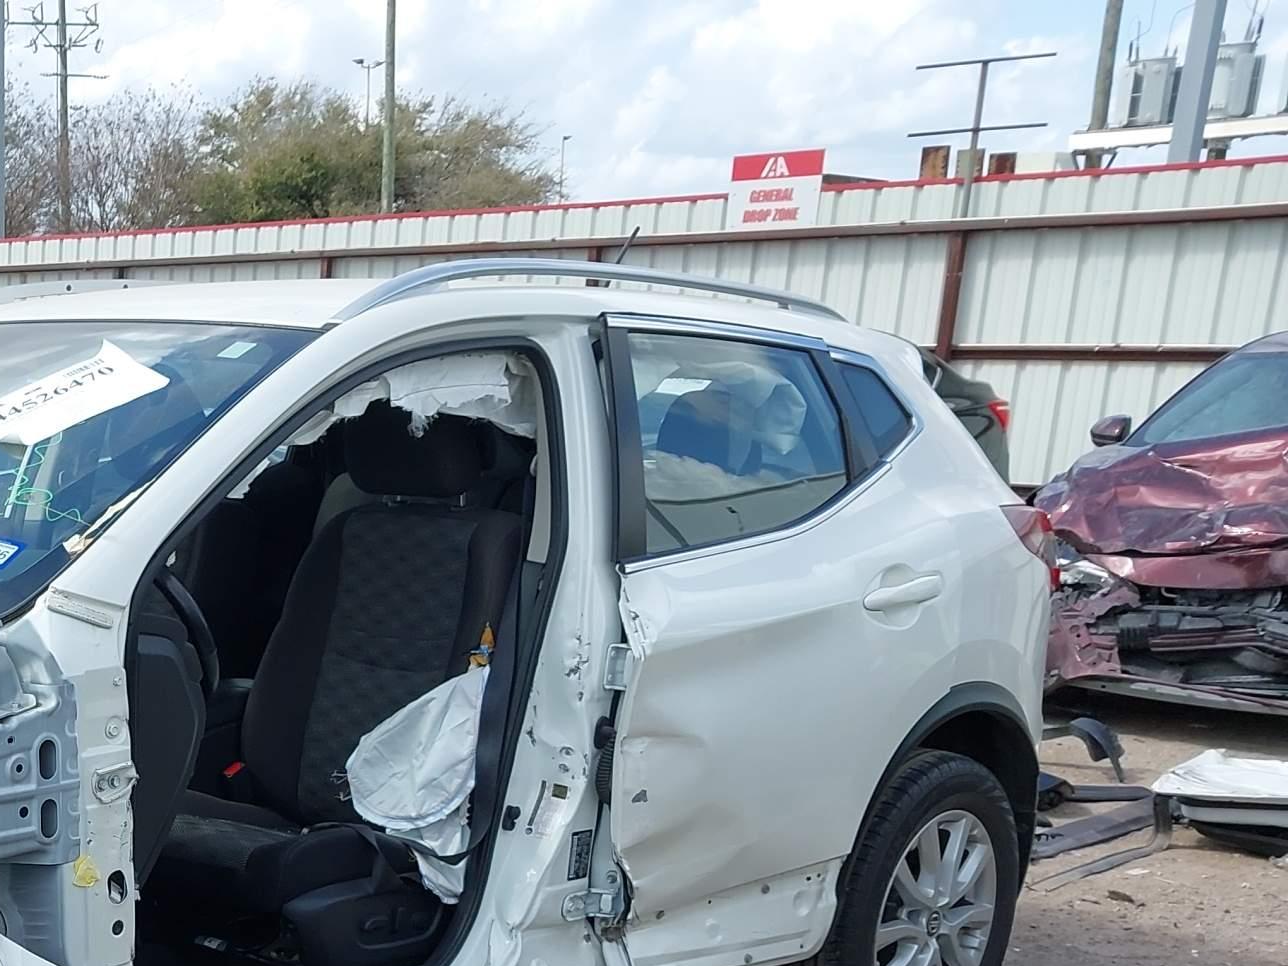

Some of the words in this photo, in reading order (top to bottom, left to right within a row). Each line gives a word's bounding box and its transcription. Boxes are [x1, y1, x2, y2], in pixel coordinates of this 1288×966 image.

[749, 187, 794, 203] GENERAL
[742, 209, 772, 223] DROP
[772, 206, 800, 221] ZONE
